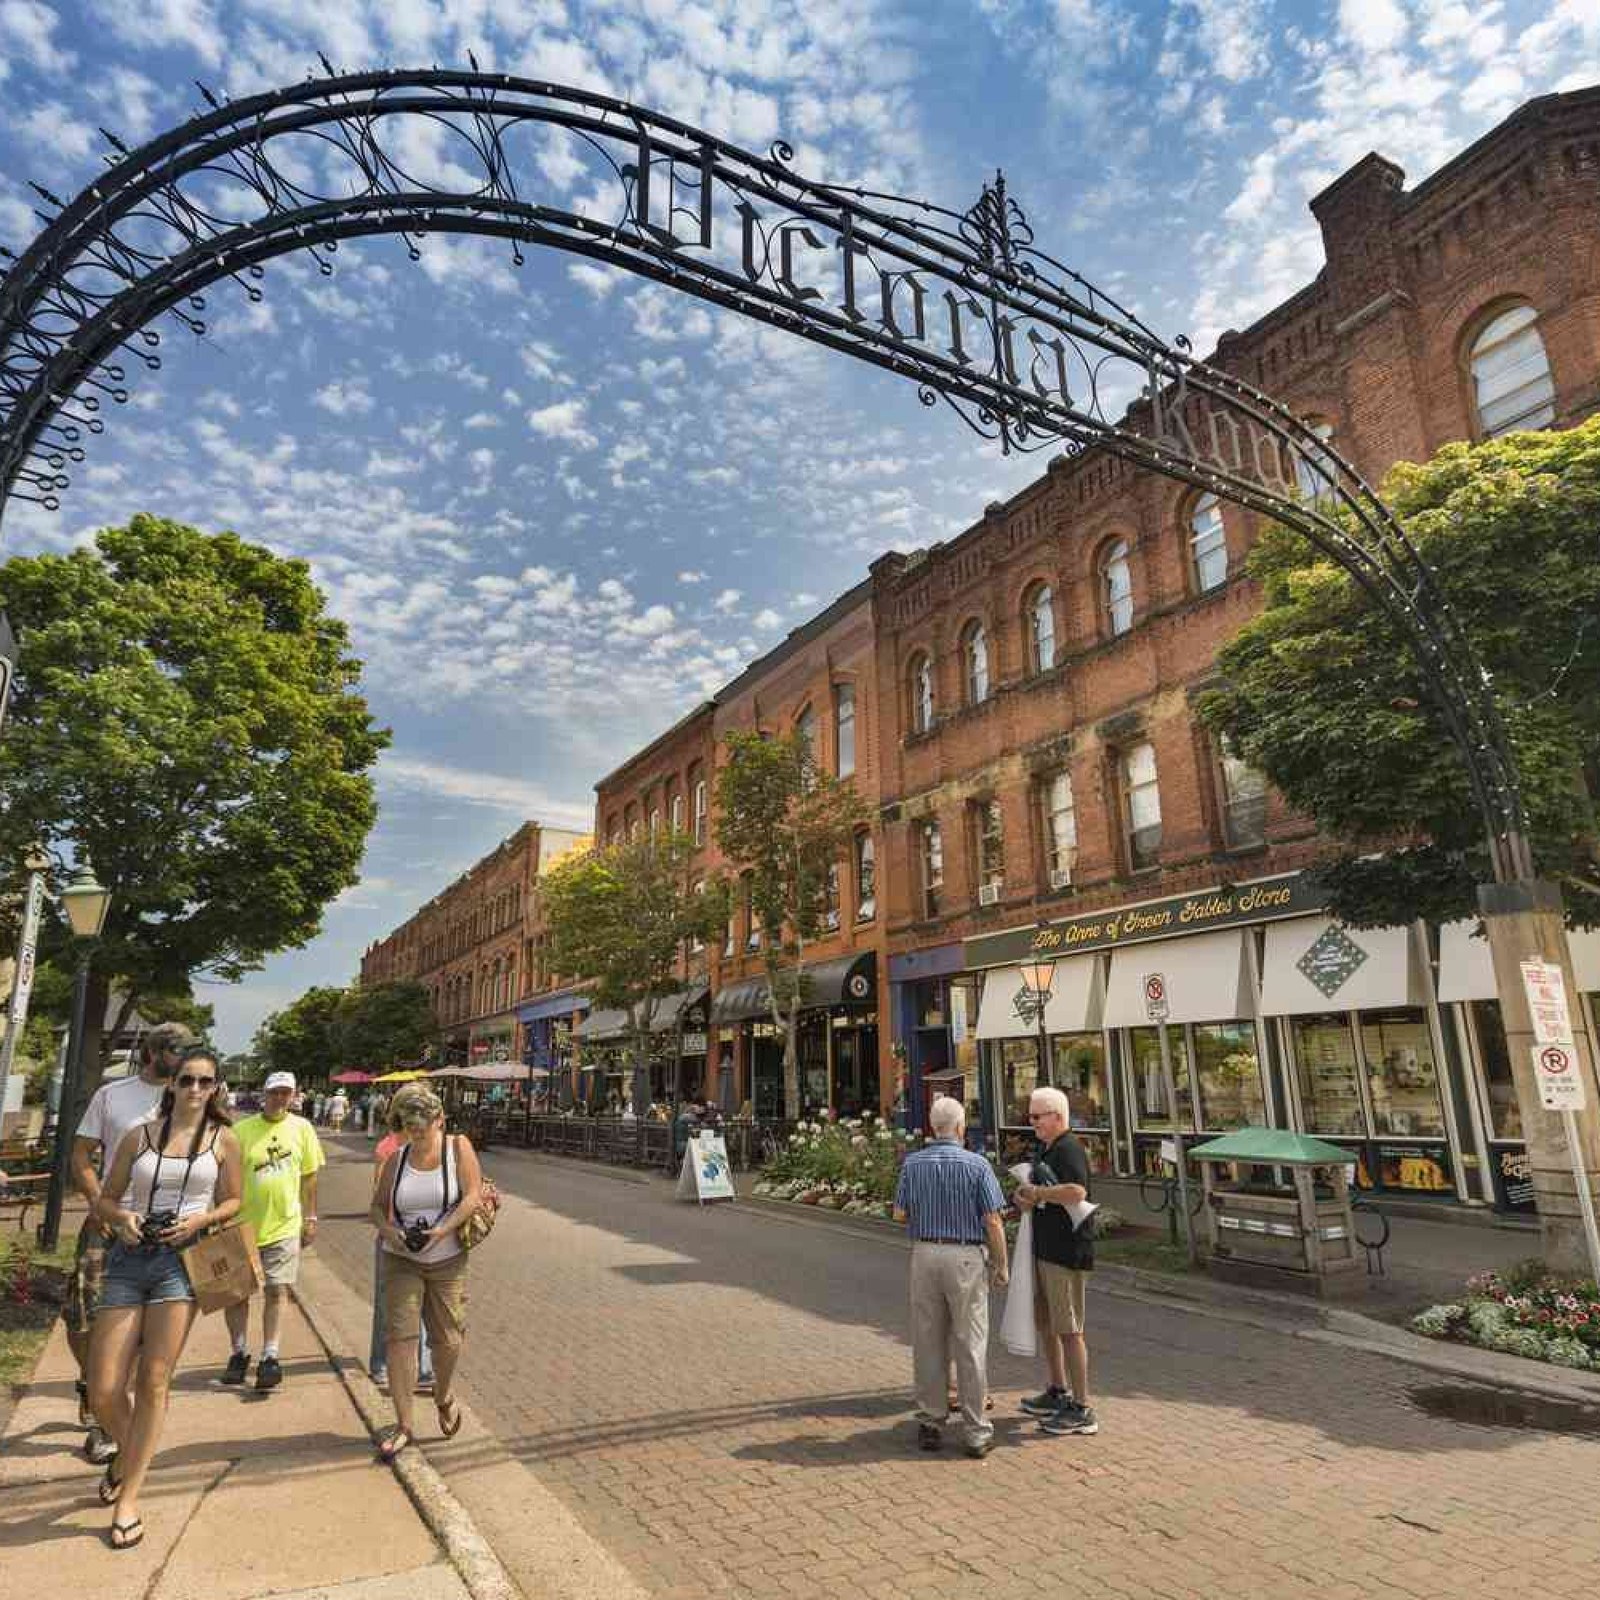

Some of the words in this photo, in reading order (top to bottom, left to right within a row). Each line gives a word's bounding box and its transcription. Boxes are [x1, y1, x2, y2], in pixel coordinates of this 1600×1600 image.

[620, 116, 1075, 412] Victoria
[1033, 929, 1061, 949] The
[1065, 922, 1100, 945] Anne
[1106, 914, 1121, 941] of
[1123, 908, 1172, 935] Green
[1178, 896, 1233, 924] Gables
[1238, 883, 1291, 912] Store
